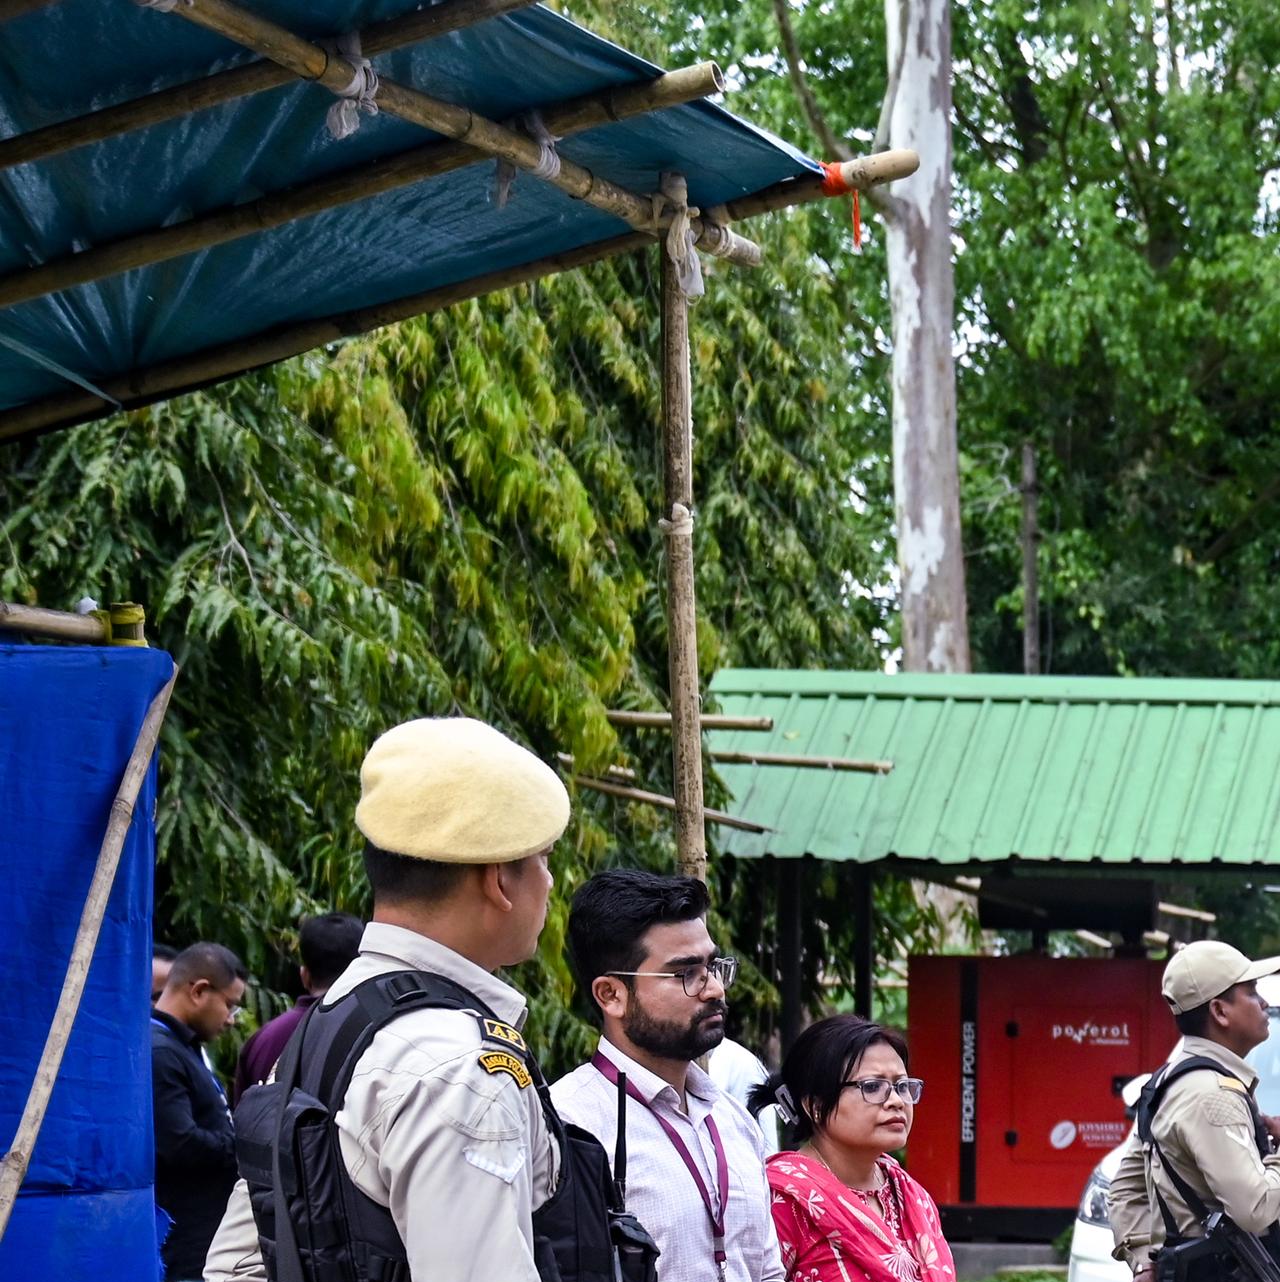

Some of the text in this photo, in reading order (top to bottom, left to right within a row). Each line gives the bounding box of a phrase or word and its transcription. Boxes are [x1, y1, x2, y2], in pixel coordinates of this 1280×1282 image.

[492, 1024, 519, 1042] AP
[962, 1021, 976, 1143] EFFICIENT POWER
